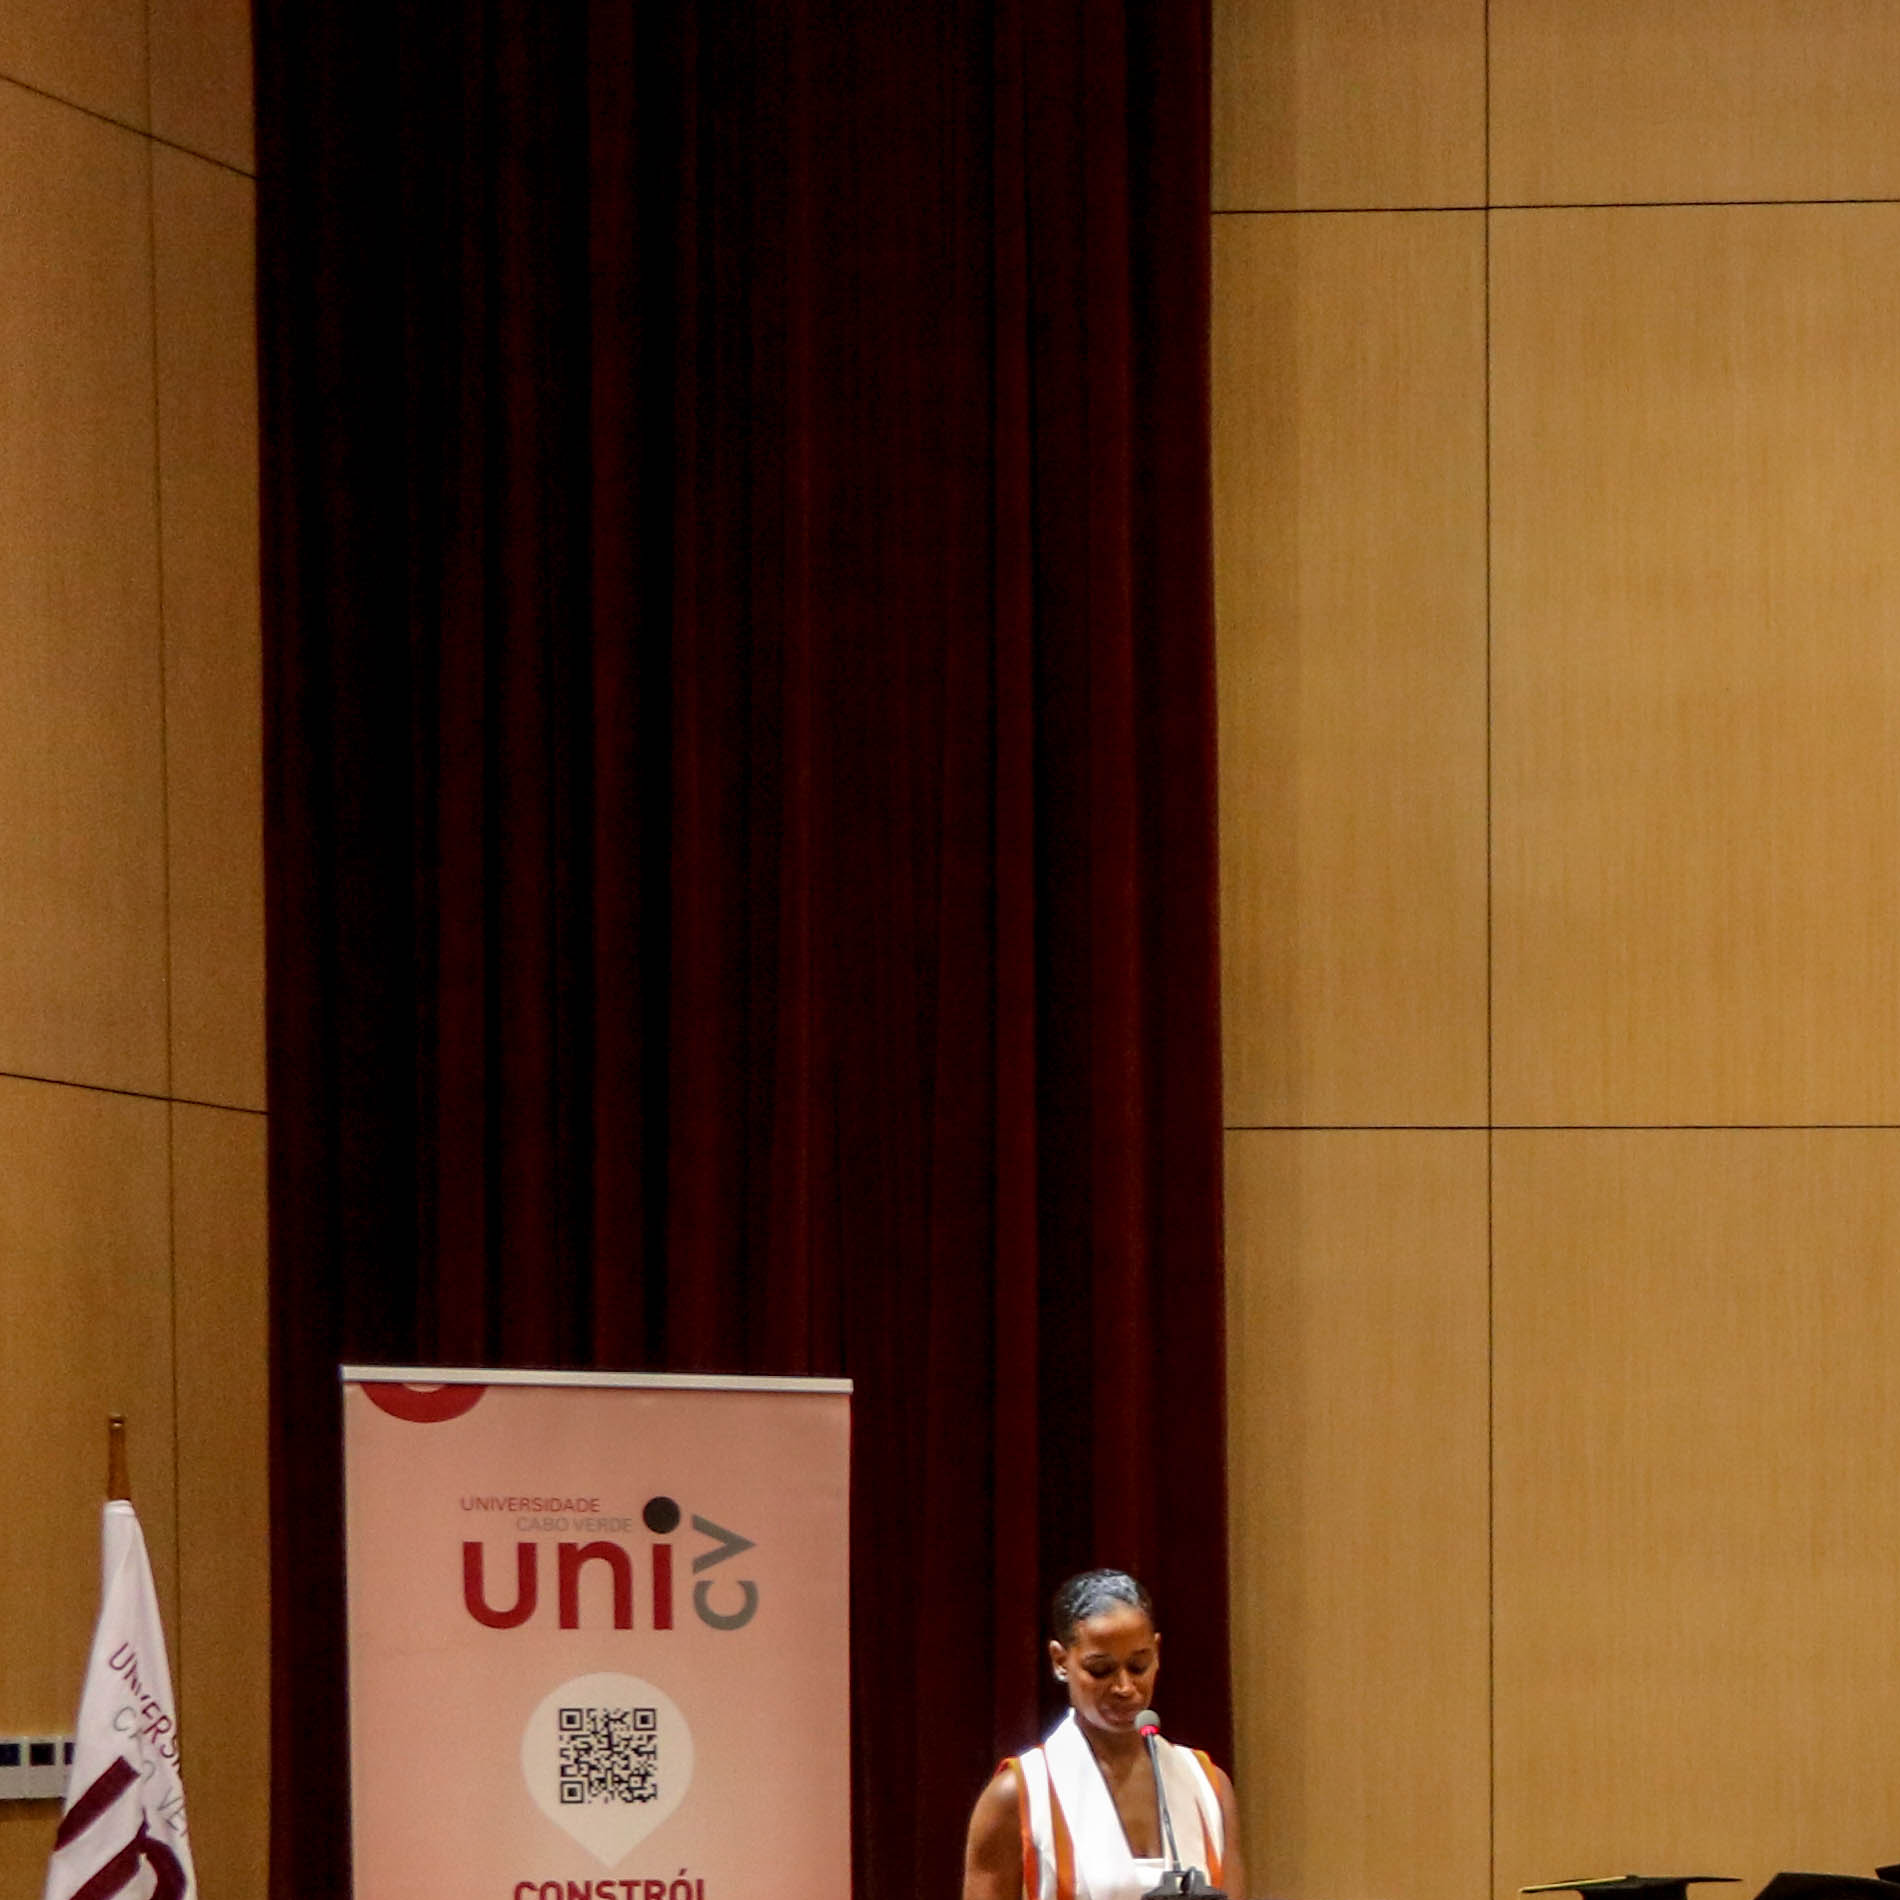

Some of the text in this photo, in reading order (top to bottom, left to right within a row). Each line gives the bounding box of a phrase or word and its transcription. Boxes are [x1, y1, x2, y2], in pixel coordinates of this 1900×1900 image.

[460, 1497, 600, 1513] UNIVERSIDADE
[516, 1517, 632, 1532] CABO VERDE
[462, 1496, 681, 1630] uni
